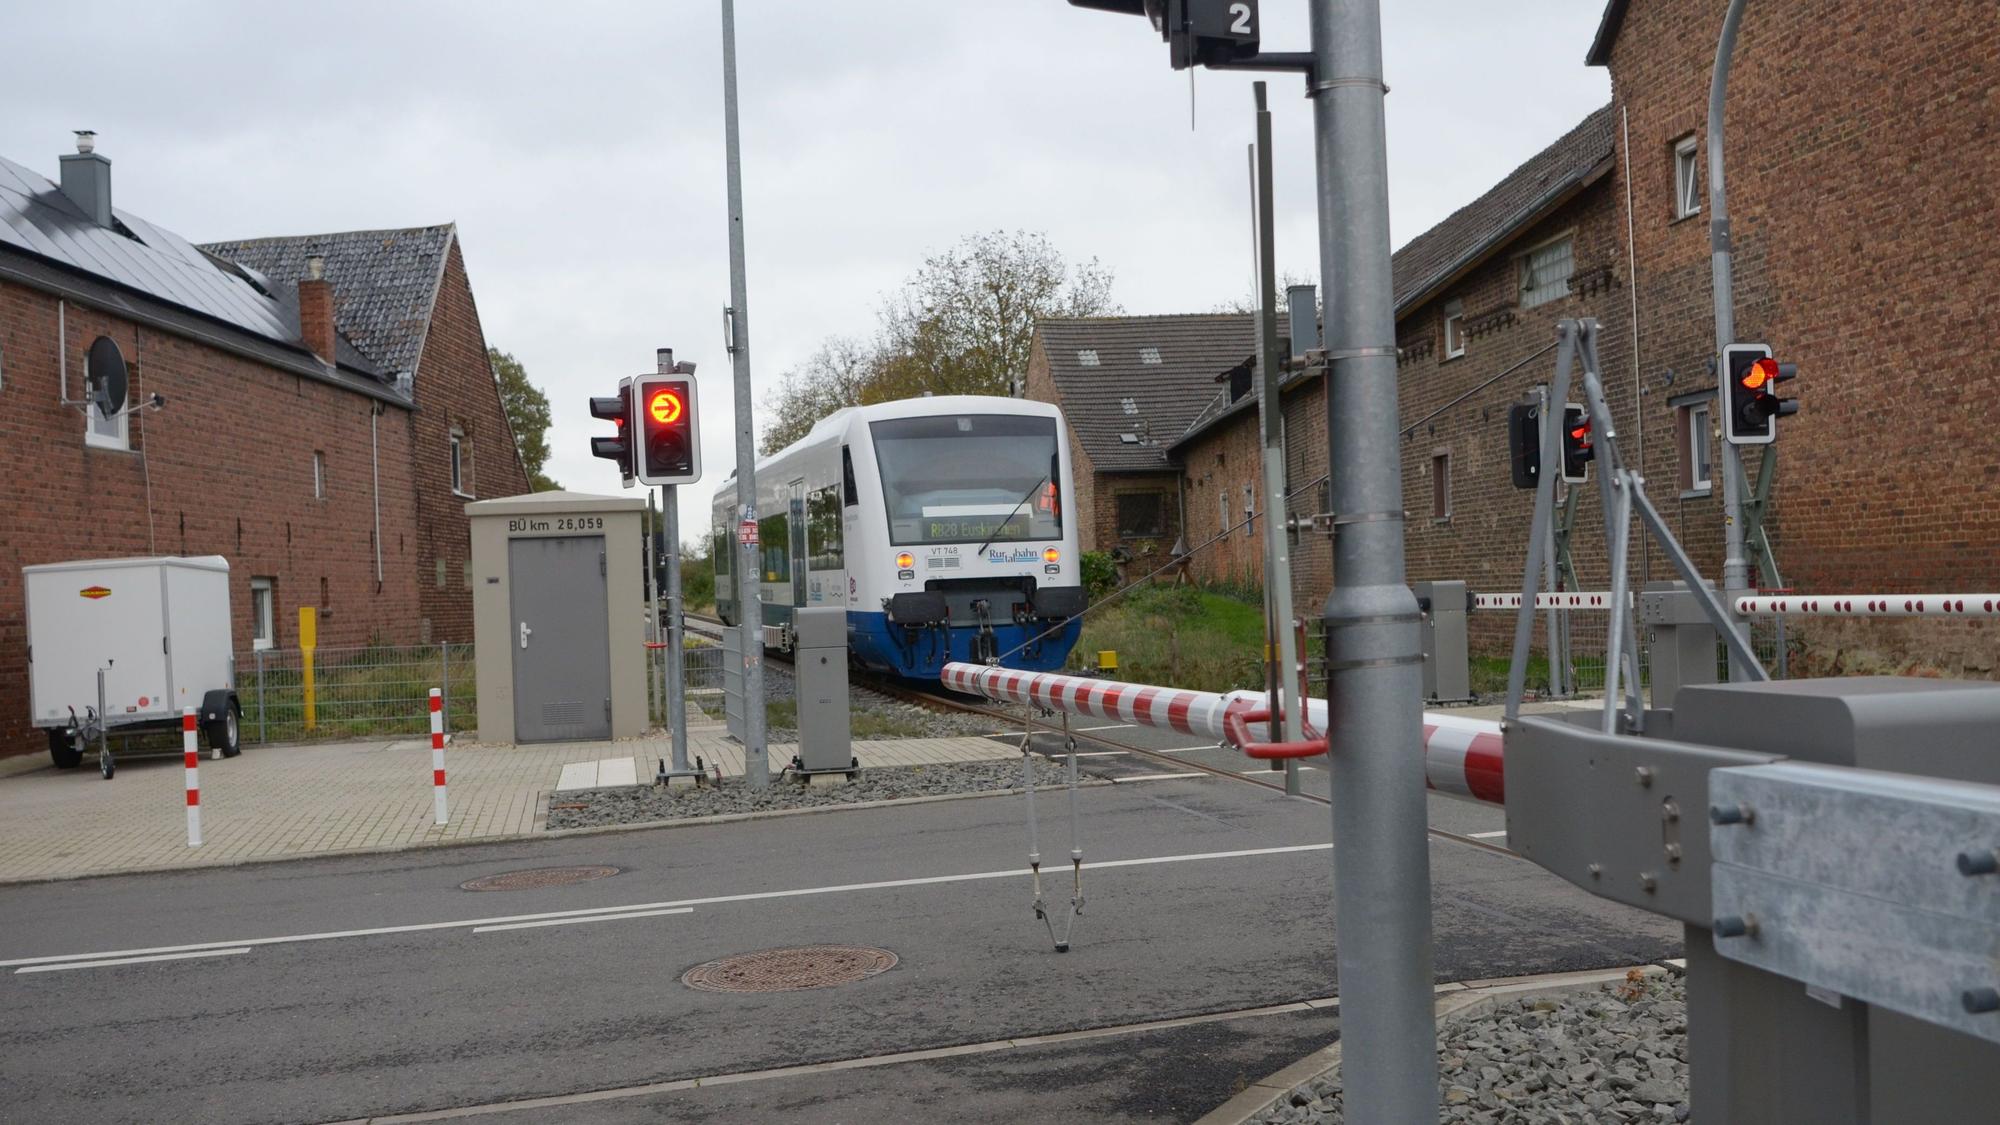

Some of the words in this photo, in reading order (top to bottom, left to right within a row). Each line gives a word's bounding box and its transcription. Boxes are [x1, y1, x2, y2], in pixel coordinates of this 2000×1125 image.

[1229, 3, 1251, 34] 2
[509, 518, 527, 531] BÜ
[530, 520, 549, 531] km
[558, 518, 603, 531] 26,059
